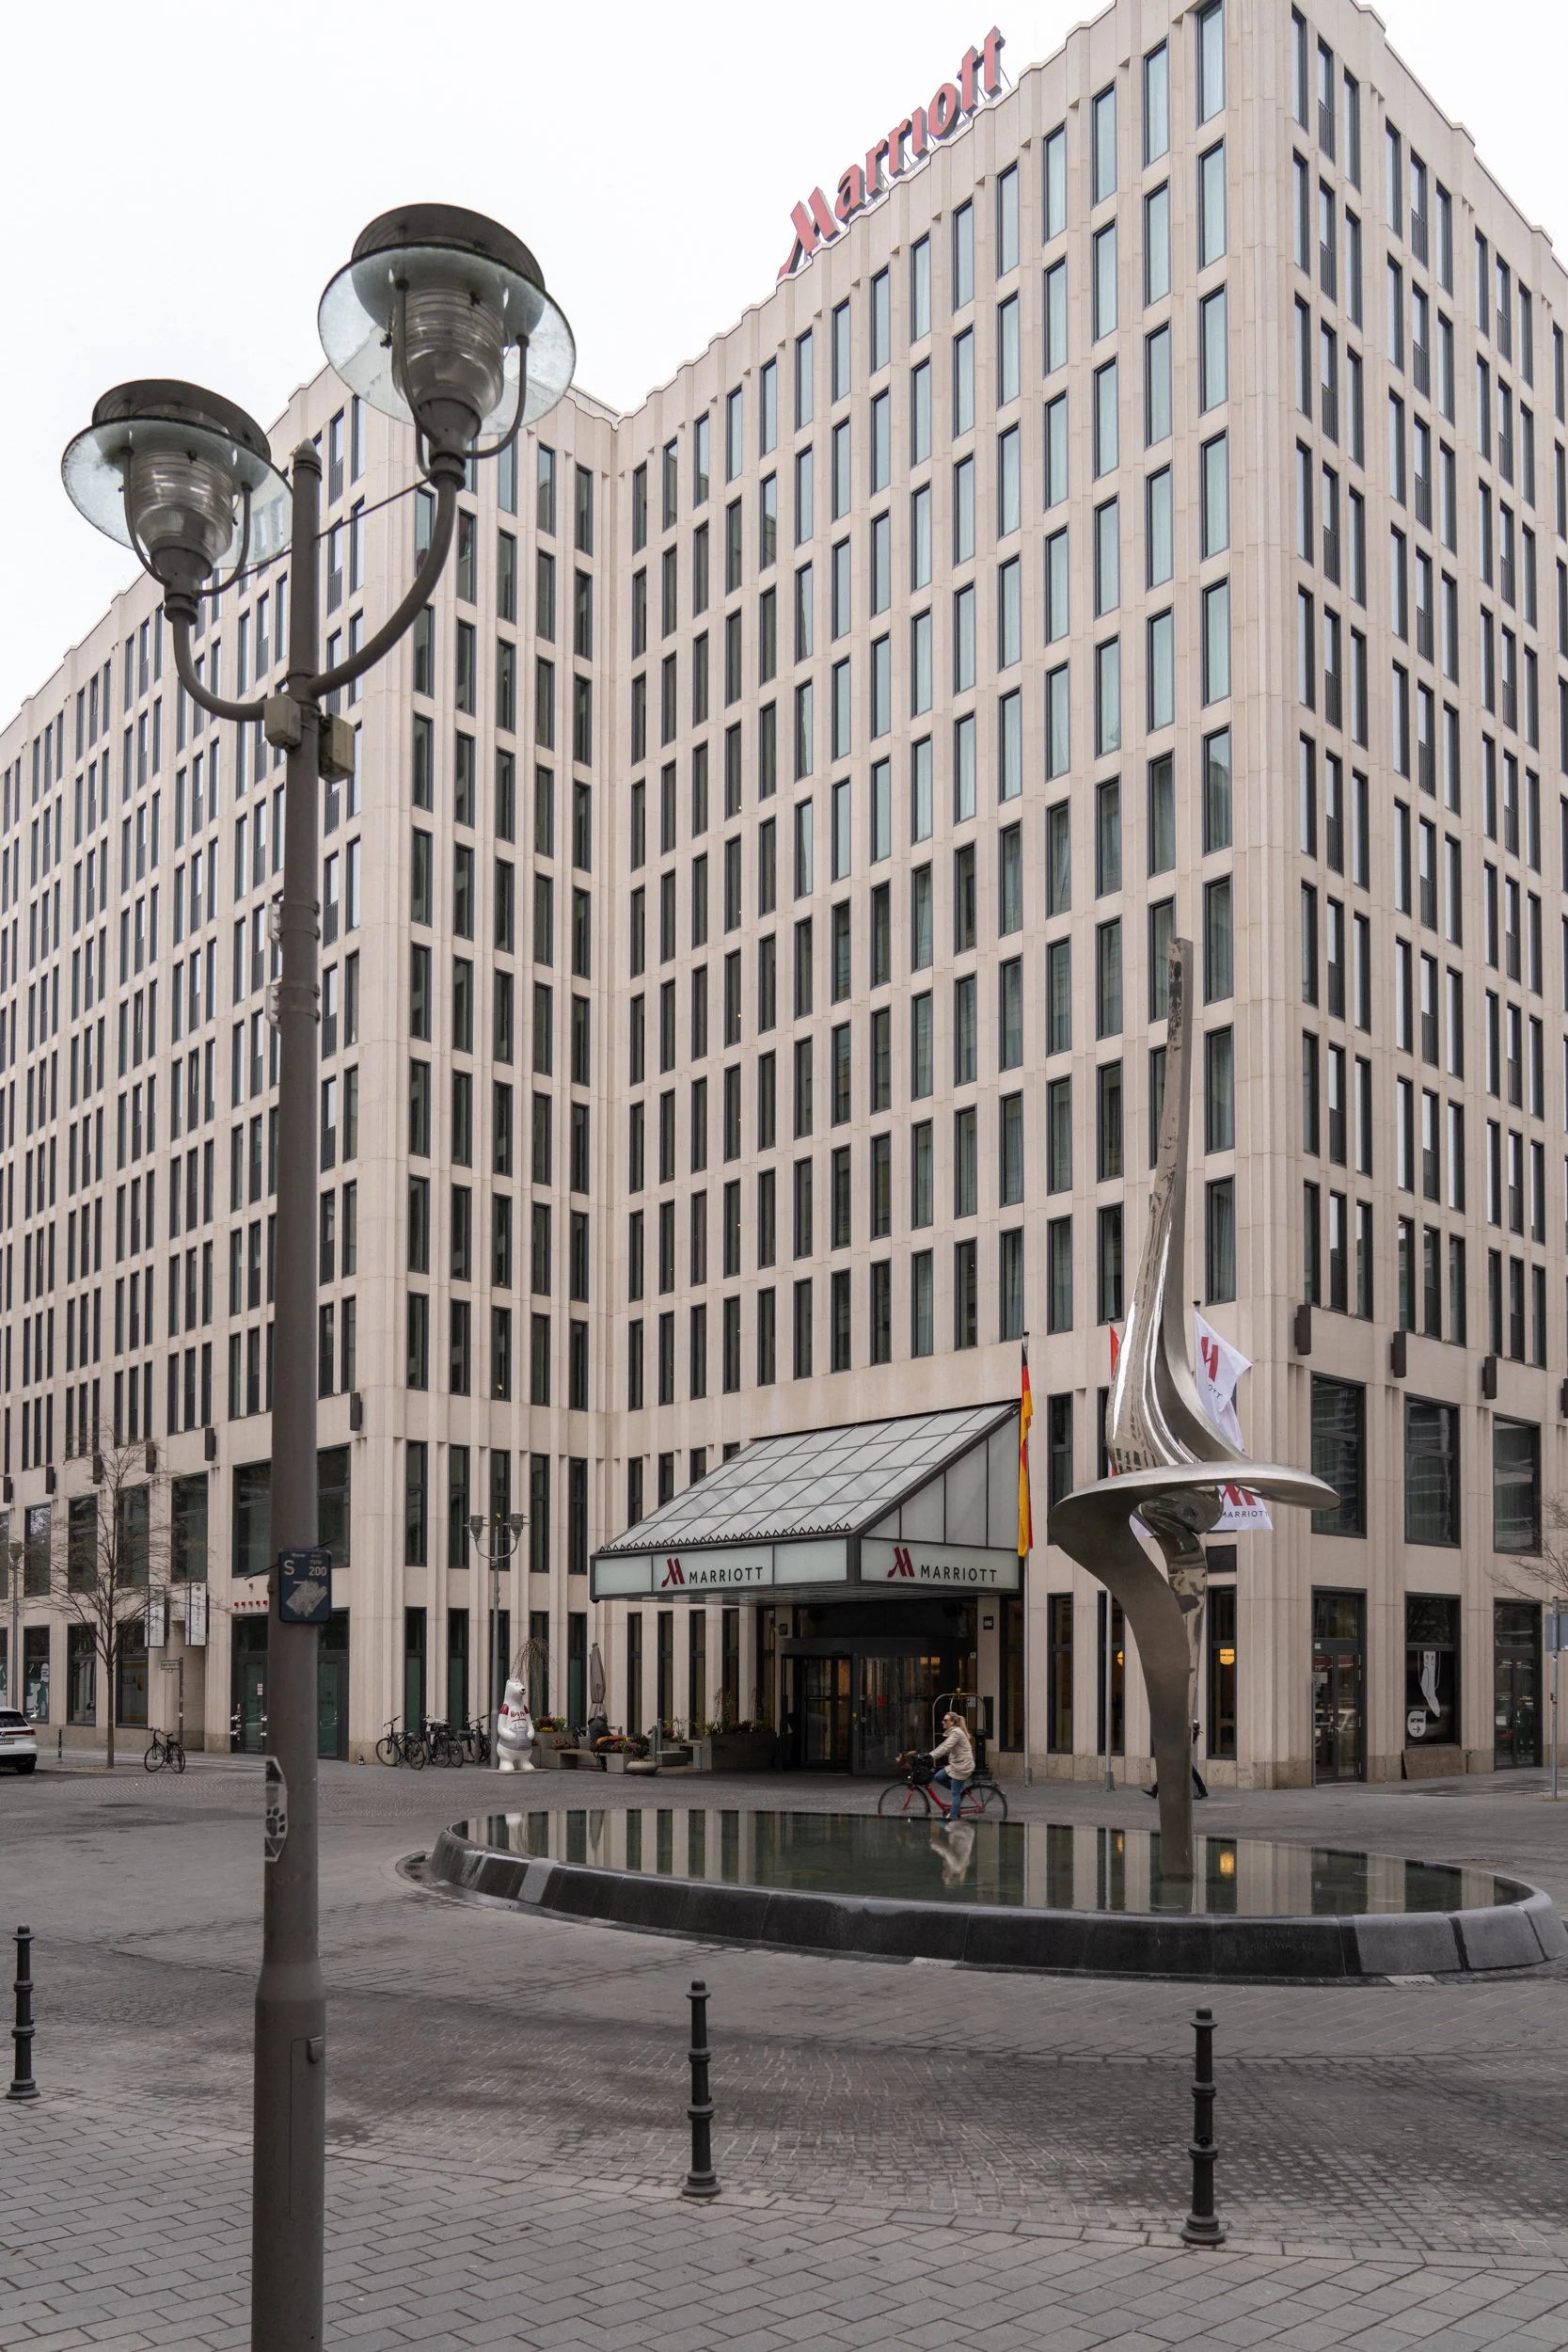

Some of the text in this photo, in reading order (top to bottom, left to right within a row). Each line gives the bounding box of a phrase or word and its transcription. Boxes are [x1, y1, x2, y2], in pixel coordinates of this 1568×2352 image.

[776, 24, 1006, 280] Marriott
[283, 1559, 295, 1576] S
[309, 1565, 327, 1577] 200
[689, 1566, 763, 1584] MARRIOTT
[920, 1565, 997, 1582] MARRIOTT
